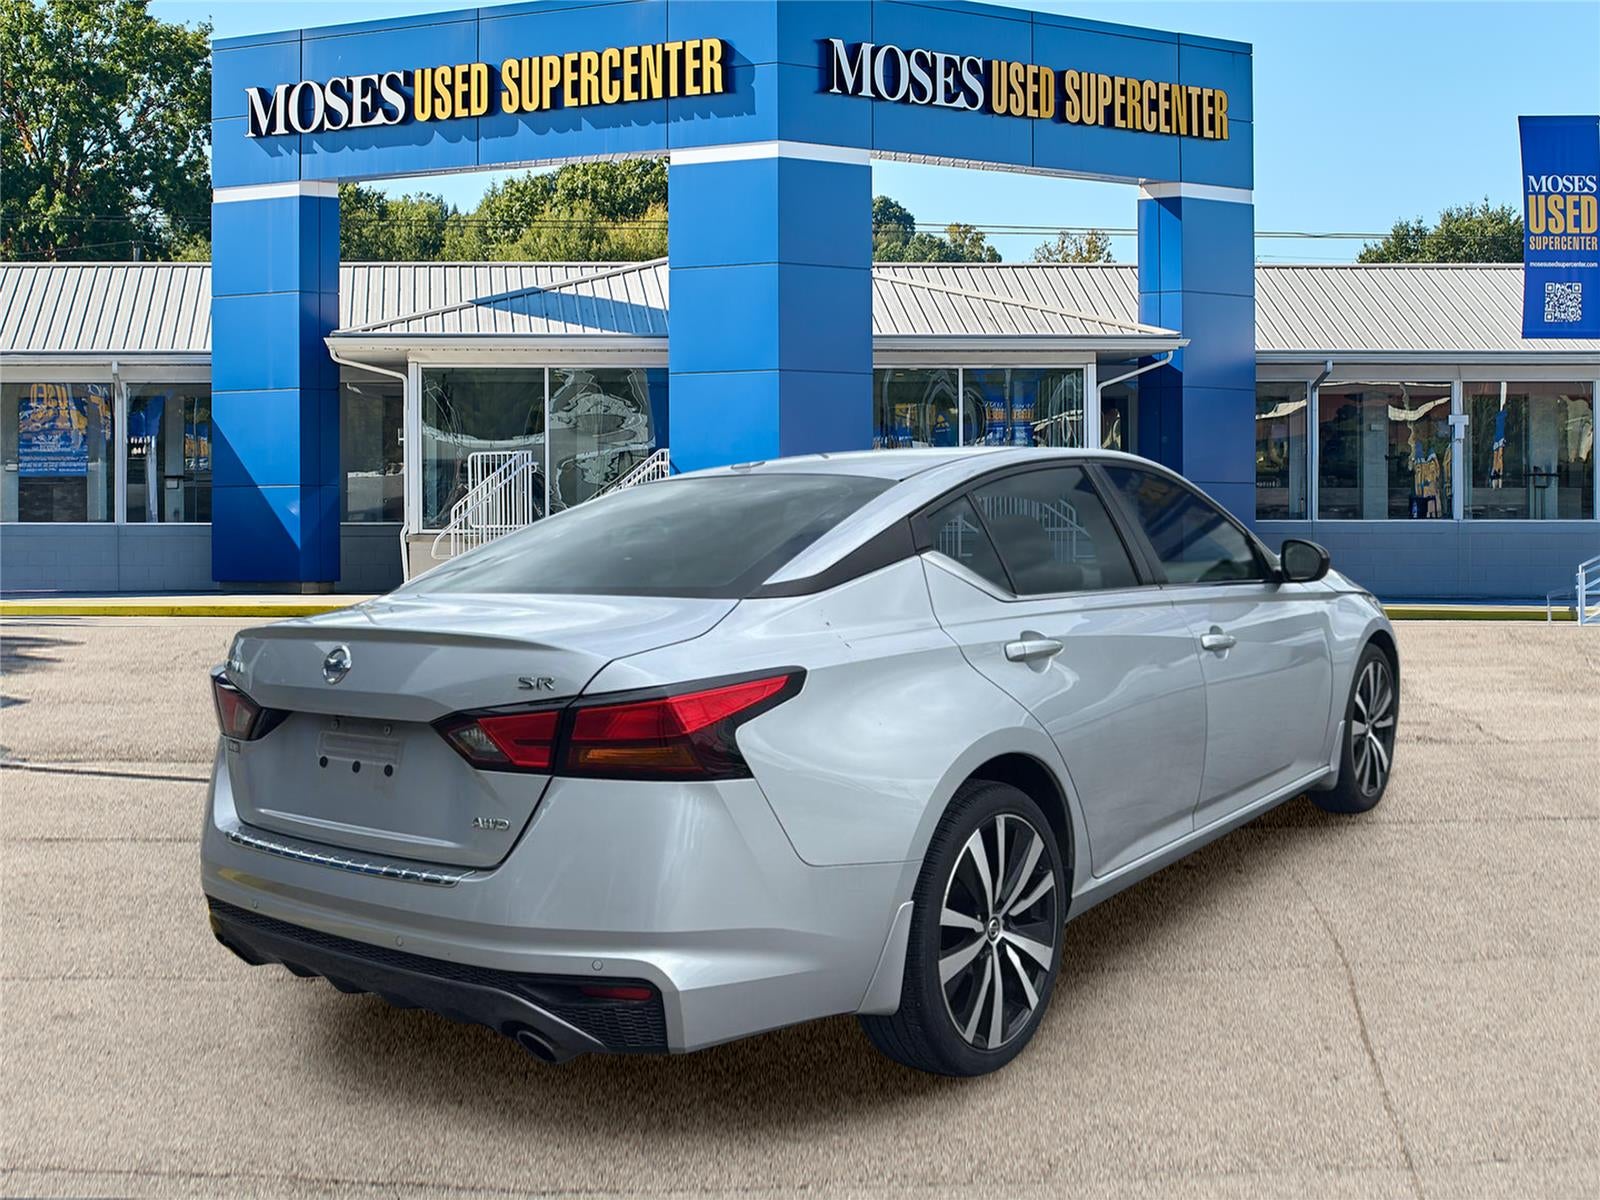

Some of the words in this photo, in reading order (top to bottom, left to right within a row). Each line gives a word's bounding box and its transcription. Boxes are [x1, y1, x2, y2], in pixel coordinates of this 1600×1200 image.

[245, 70, 406, 138] MOSES
[413, 62, 488, 122] USED
[500, 38, 725, 114] SUPERCENTER
[828, 38, 985, 111] MOSES
[991, 60, 1056, 119] USED
[1064, 69, 1230, 141] SUPERCENTER
[1527, 175, 1597, 193] MOSES
[1528, 194, 1598, 235] USED
[1529, 235, 1598, 250] SUPERCENTER
[518, 675, 555, 691] SR
[471, 816, 511, 831] AWD
